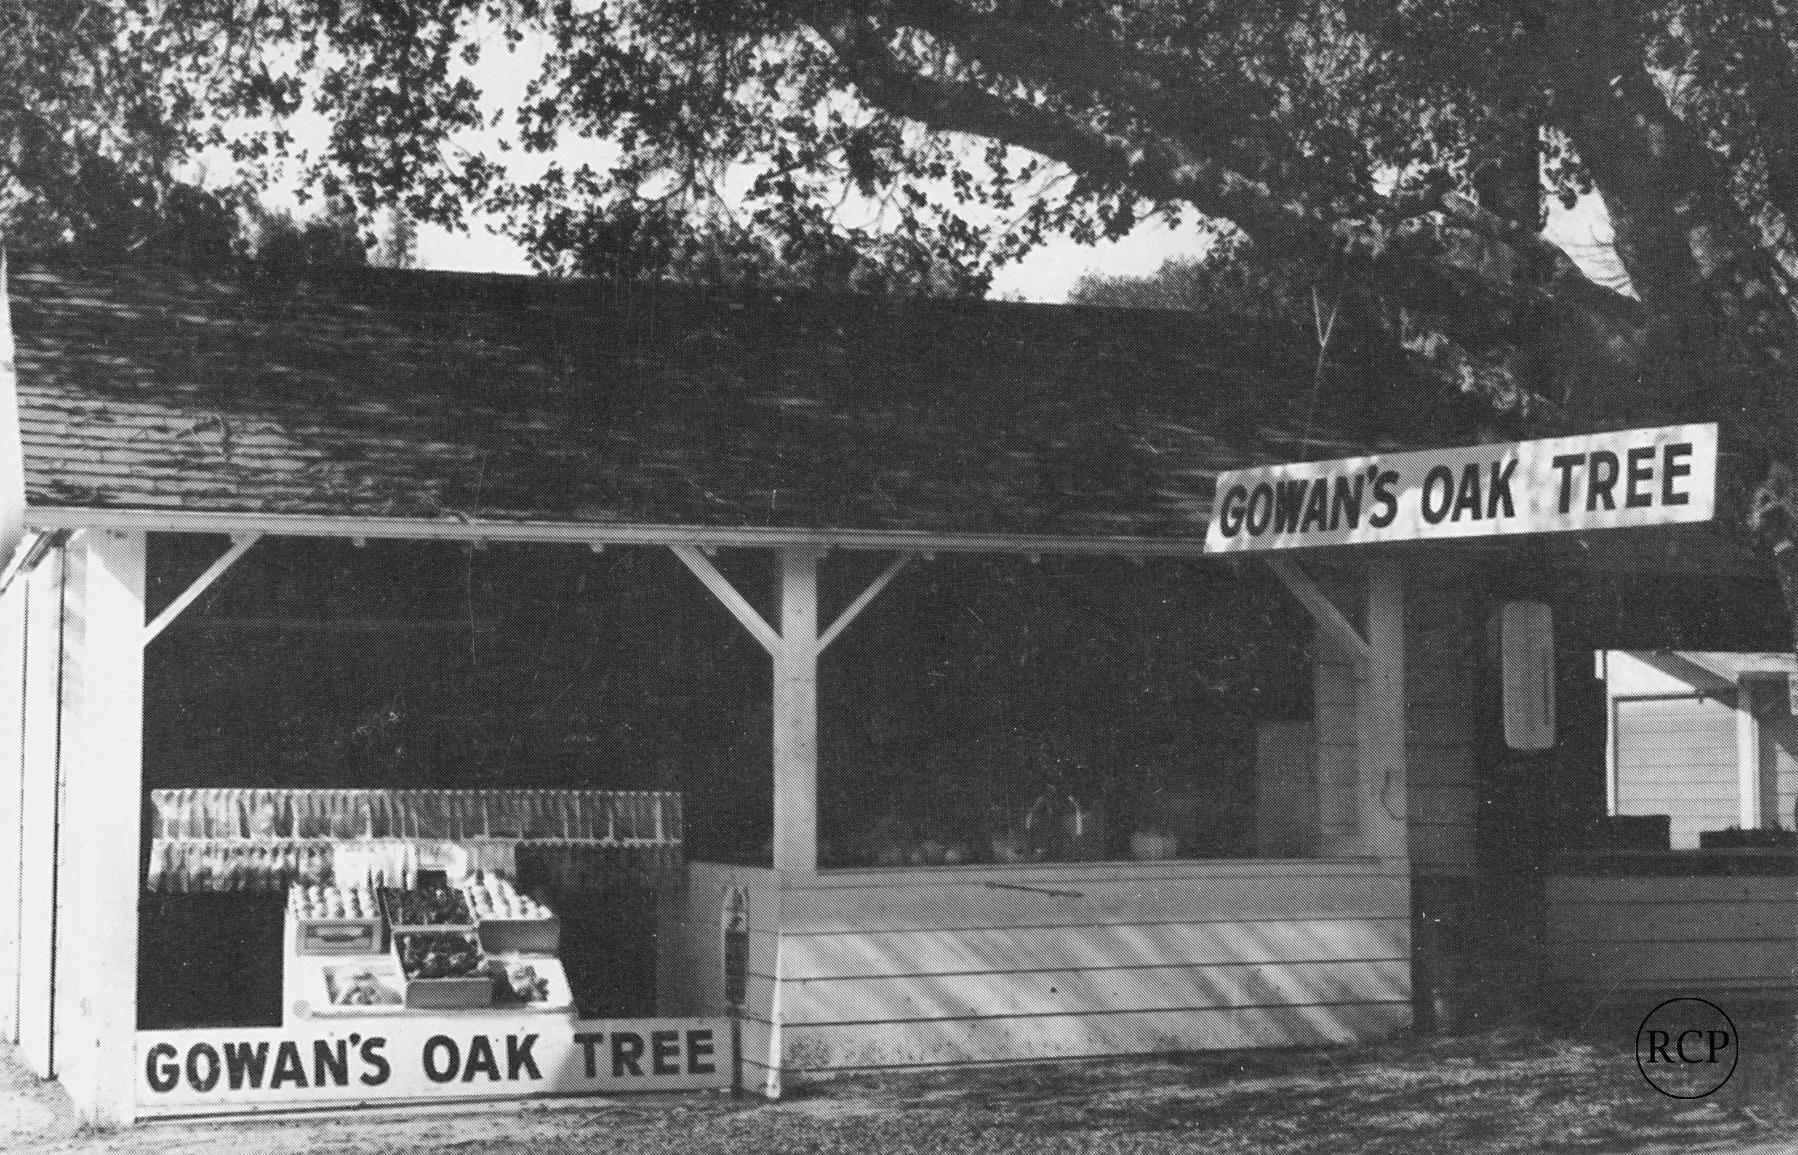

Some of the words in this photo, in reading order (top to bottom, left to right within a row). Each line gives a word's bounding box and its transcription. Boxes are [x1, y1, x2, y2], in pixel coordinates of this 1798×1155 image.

[1219, 463, 1400, 539] GOWAN'S
[1420, 456, 1519, 524] OAK
[1551, 442, 1693, 514] TREE
[145, 1033, 391, 1094] GOWAN'S
[422, 1033, 544, 1084] OAK
[573, 1029, 717, 1080] TREE
